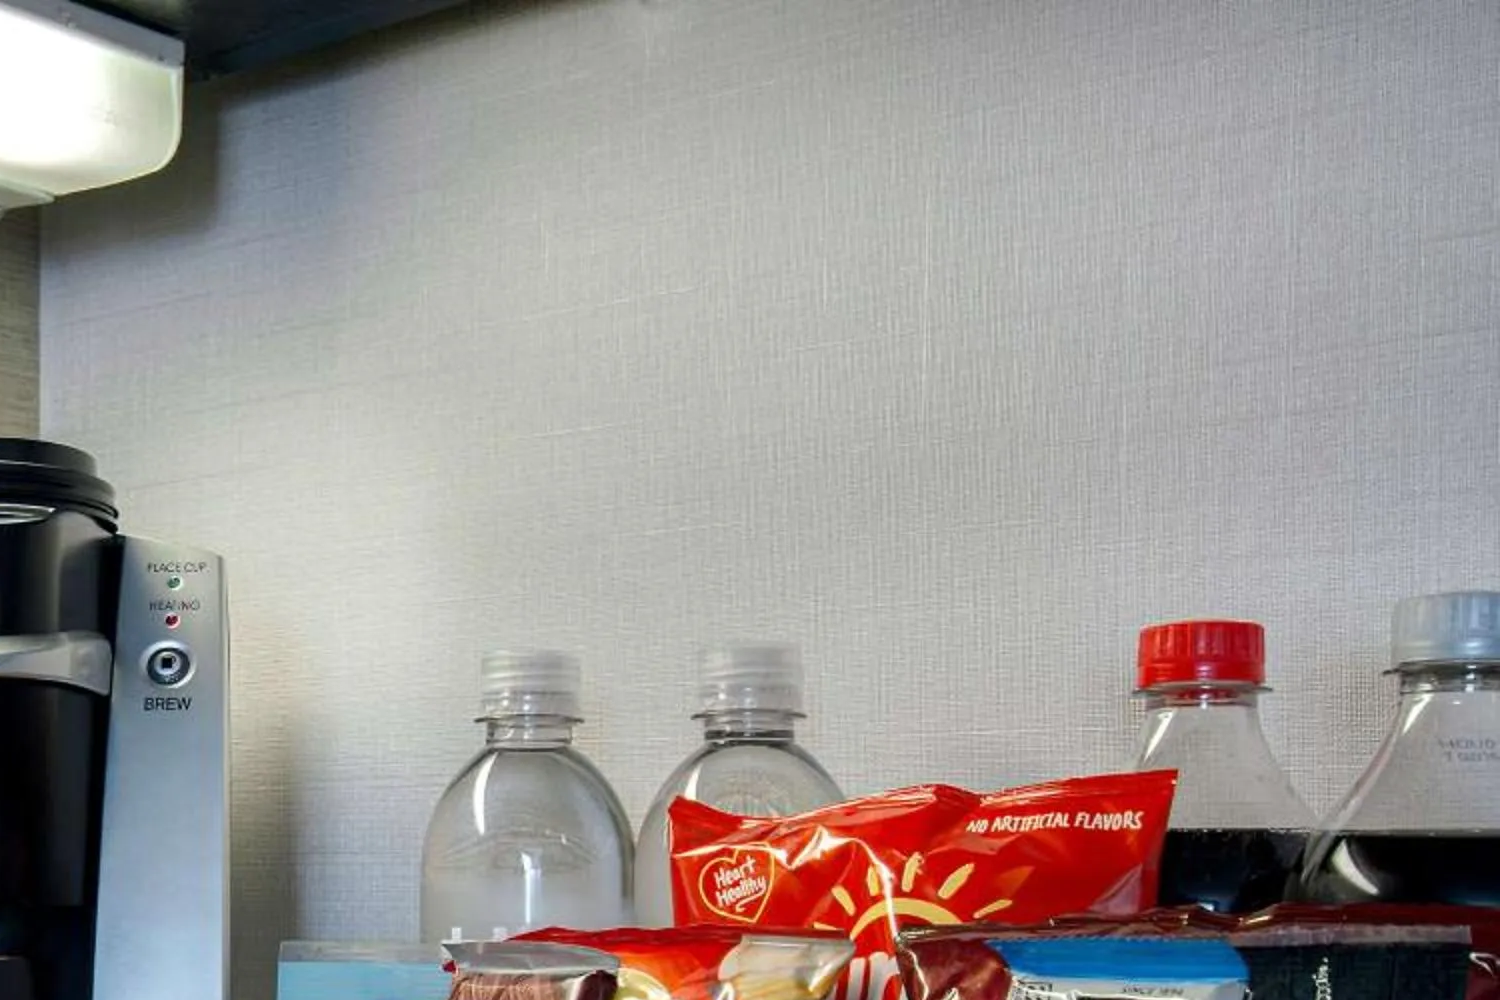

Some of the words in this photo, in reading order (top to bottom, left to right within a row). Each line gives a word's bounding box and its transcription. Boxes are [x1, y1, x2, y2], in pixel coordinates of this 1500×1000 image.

[144, 698, 192, 711] BREW
[966, 820, 988, 833] NO
[991, 812, 1070, 833] ARTIFICIAL
[1074, 811, 1144, 831] FLAVORS
[713, 855, 756, 888] Heart
[715, 876, 766, 912] Healthy
